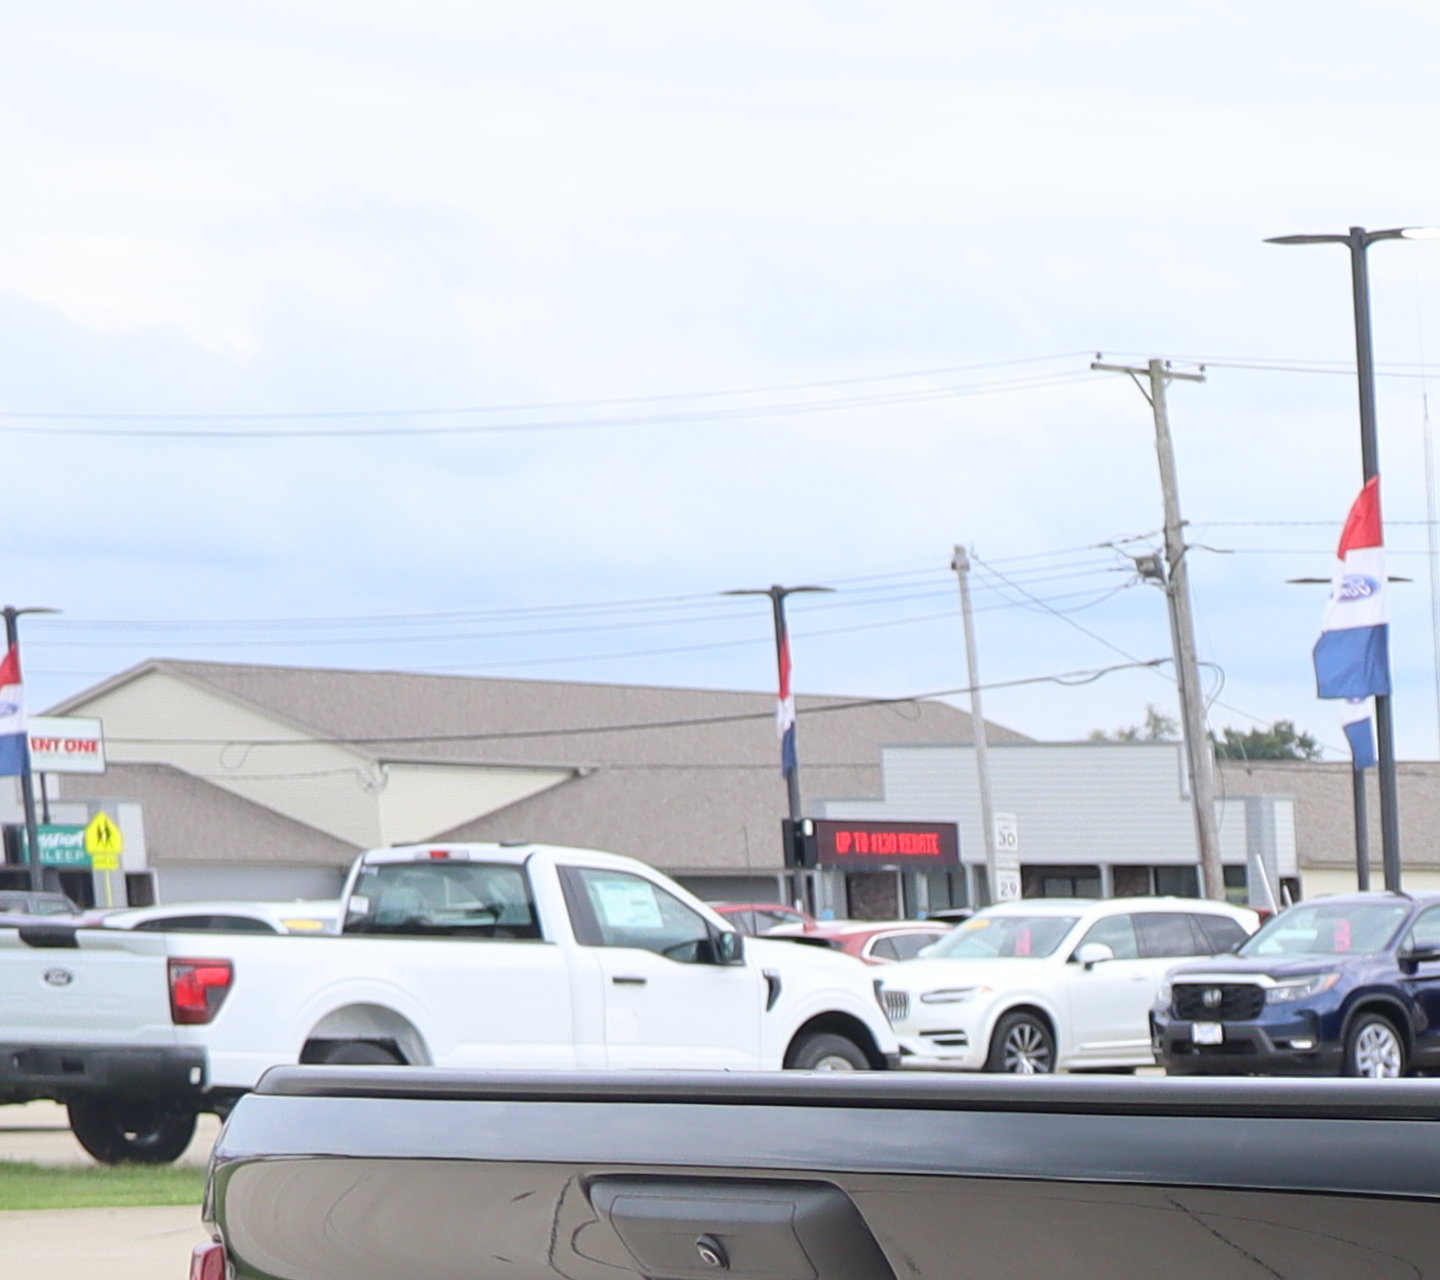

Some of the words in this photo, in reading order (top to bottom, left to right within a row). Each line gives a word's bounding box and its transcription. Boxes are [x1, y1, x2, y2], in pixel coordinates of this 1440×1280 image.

[31, 738, 60, 753] ENT
[64, 739, 98, 754] ONE
[835, 831, 851, 854] UP
[853, 831, 869, 854] TO
[998, 832, 1016, 847] 30
[1001, 881, 1018, 898] 29
